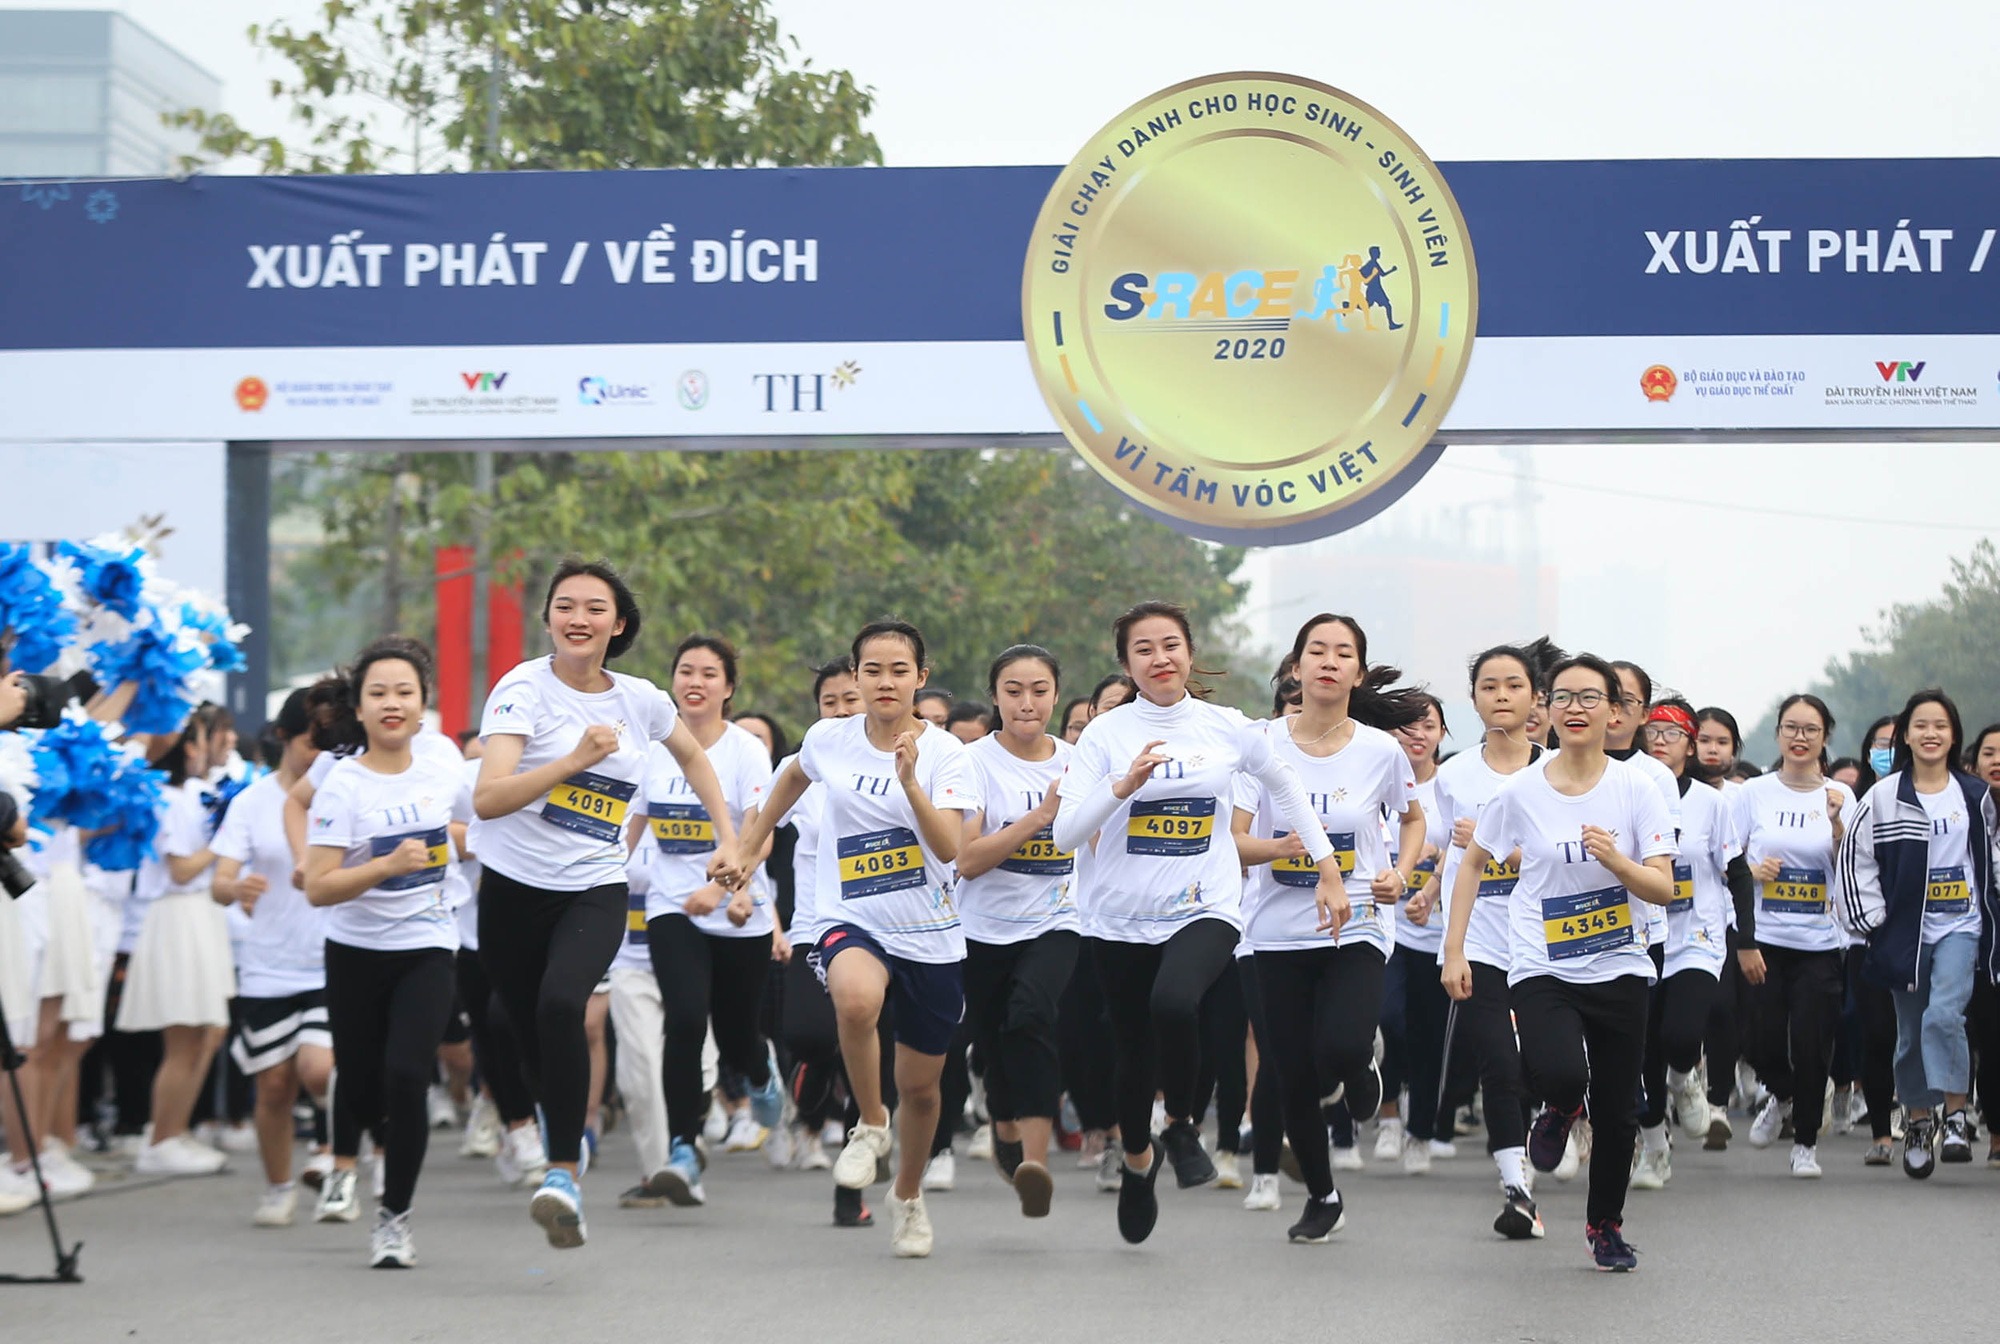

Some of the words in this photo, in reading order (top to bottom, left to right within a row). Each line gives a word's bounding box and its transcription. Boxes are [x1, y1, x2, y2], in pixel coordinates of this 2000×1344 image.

[1051, 222, 1080, 275] GIẢI
[1070, 154, 1118, 218] CHẠY
[1117, 109, 1183, 158] DÀNH
[1188, 93, 1239, 119] CHO
[1247, 92, 1298, 118] HỌC
[1303, 102, 1363, 142] SINH
[1377, 149, 1426, 206] SINH
[1416, 207, 1449, 268] VIÊN
[1644, 215, 1792, 274] XUẤT
[1807, 219, 1953, 273] PHÁT
[1969, 229, 1997, 272] /
[246, 229, 393, 289] XUẤT
[404, 232, 548, 287] PHÁT
[559, 241, 590, 285] /
[604, 223, 677, 284] VỀ
[690, 229, 818, 283] ĐÍCH
[1213, 337, 1287, 361] 2020
[461, 372, 508, 391] VTV
[1683, 369, 1697, 384] BỘ
[1700, 368, 1724, 382] GIÁO
[1726, 371, 1747, 384] DỤC
[1748, 368, 1761, 381] VÀ
[1763, 368, 1785, 381] ĐÀO
[1786, 370, 1805, 384] TẠO
[1875, 361, 1927, 382] VTV
[753, 373, 828, 413] TH
[1695, 386, 1707, 397] VỤ
[1709, 384, 1731, 396] GIÁO
[1732, 386, 1752, 397] DỤC
[1826, 385, 1845, 397] ĐÀI
[1848, 385, 1891, 397] TRUYỀN
[1893, 385, 1922, 397] HÌNH
[1923, 385, 1948, 398] VIỆT
[1950, 387, 1977, 397] NAM
[1112, 436, 1149, 472] VÌ
[1153, 461, 1219, 504] TẦM
[1231, 477, 1298, 508] VÓC
[1307, 440, 1381, 494] VIỆT
[567, 790, 614, 817] 4091
[659, 823, 702, 837] 4087
[1146, 819, 1202, 835] 4097
[854, 851, 909, 874] 4083
[1775, 885, 1818, 899] 4346
[1927, 884, 1960, 898] 077
[1562, 910, 1618, 935] 4345
